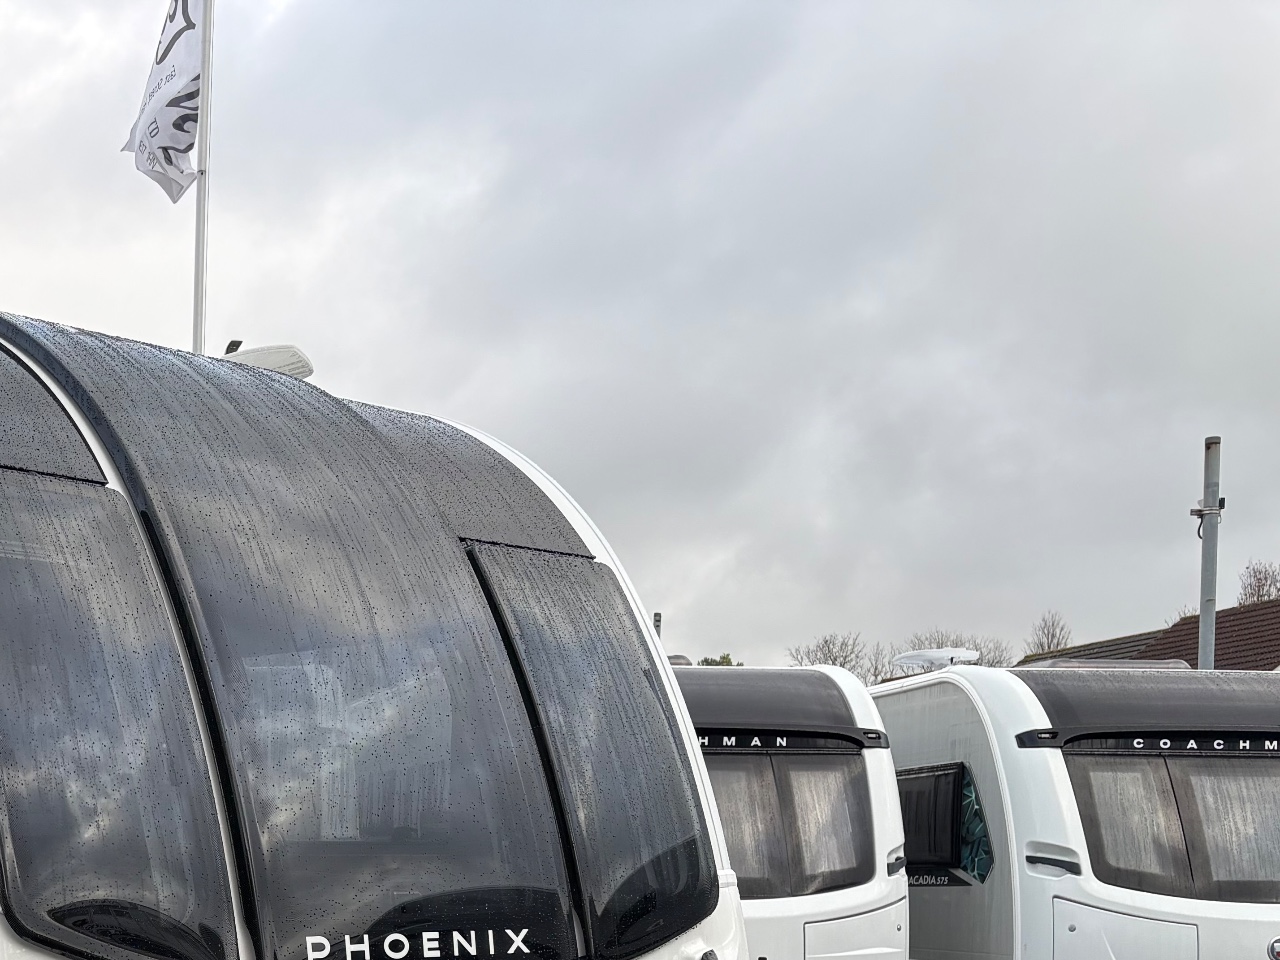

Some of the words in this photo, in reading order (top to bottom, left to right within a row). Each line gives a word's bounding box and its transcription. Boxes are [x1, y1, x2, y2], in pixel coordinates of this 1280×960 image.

[1133, 738, 1278, 750] COACHM
[909, 875, 936, 885] ACADIA
[936, 876, 949, 885] 575
